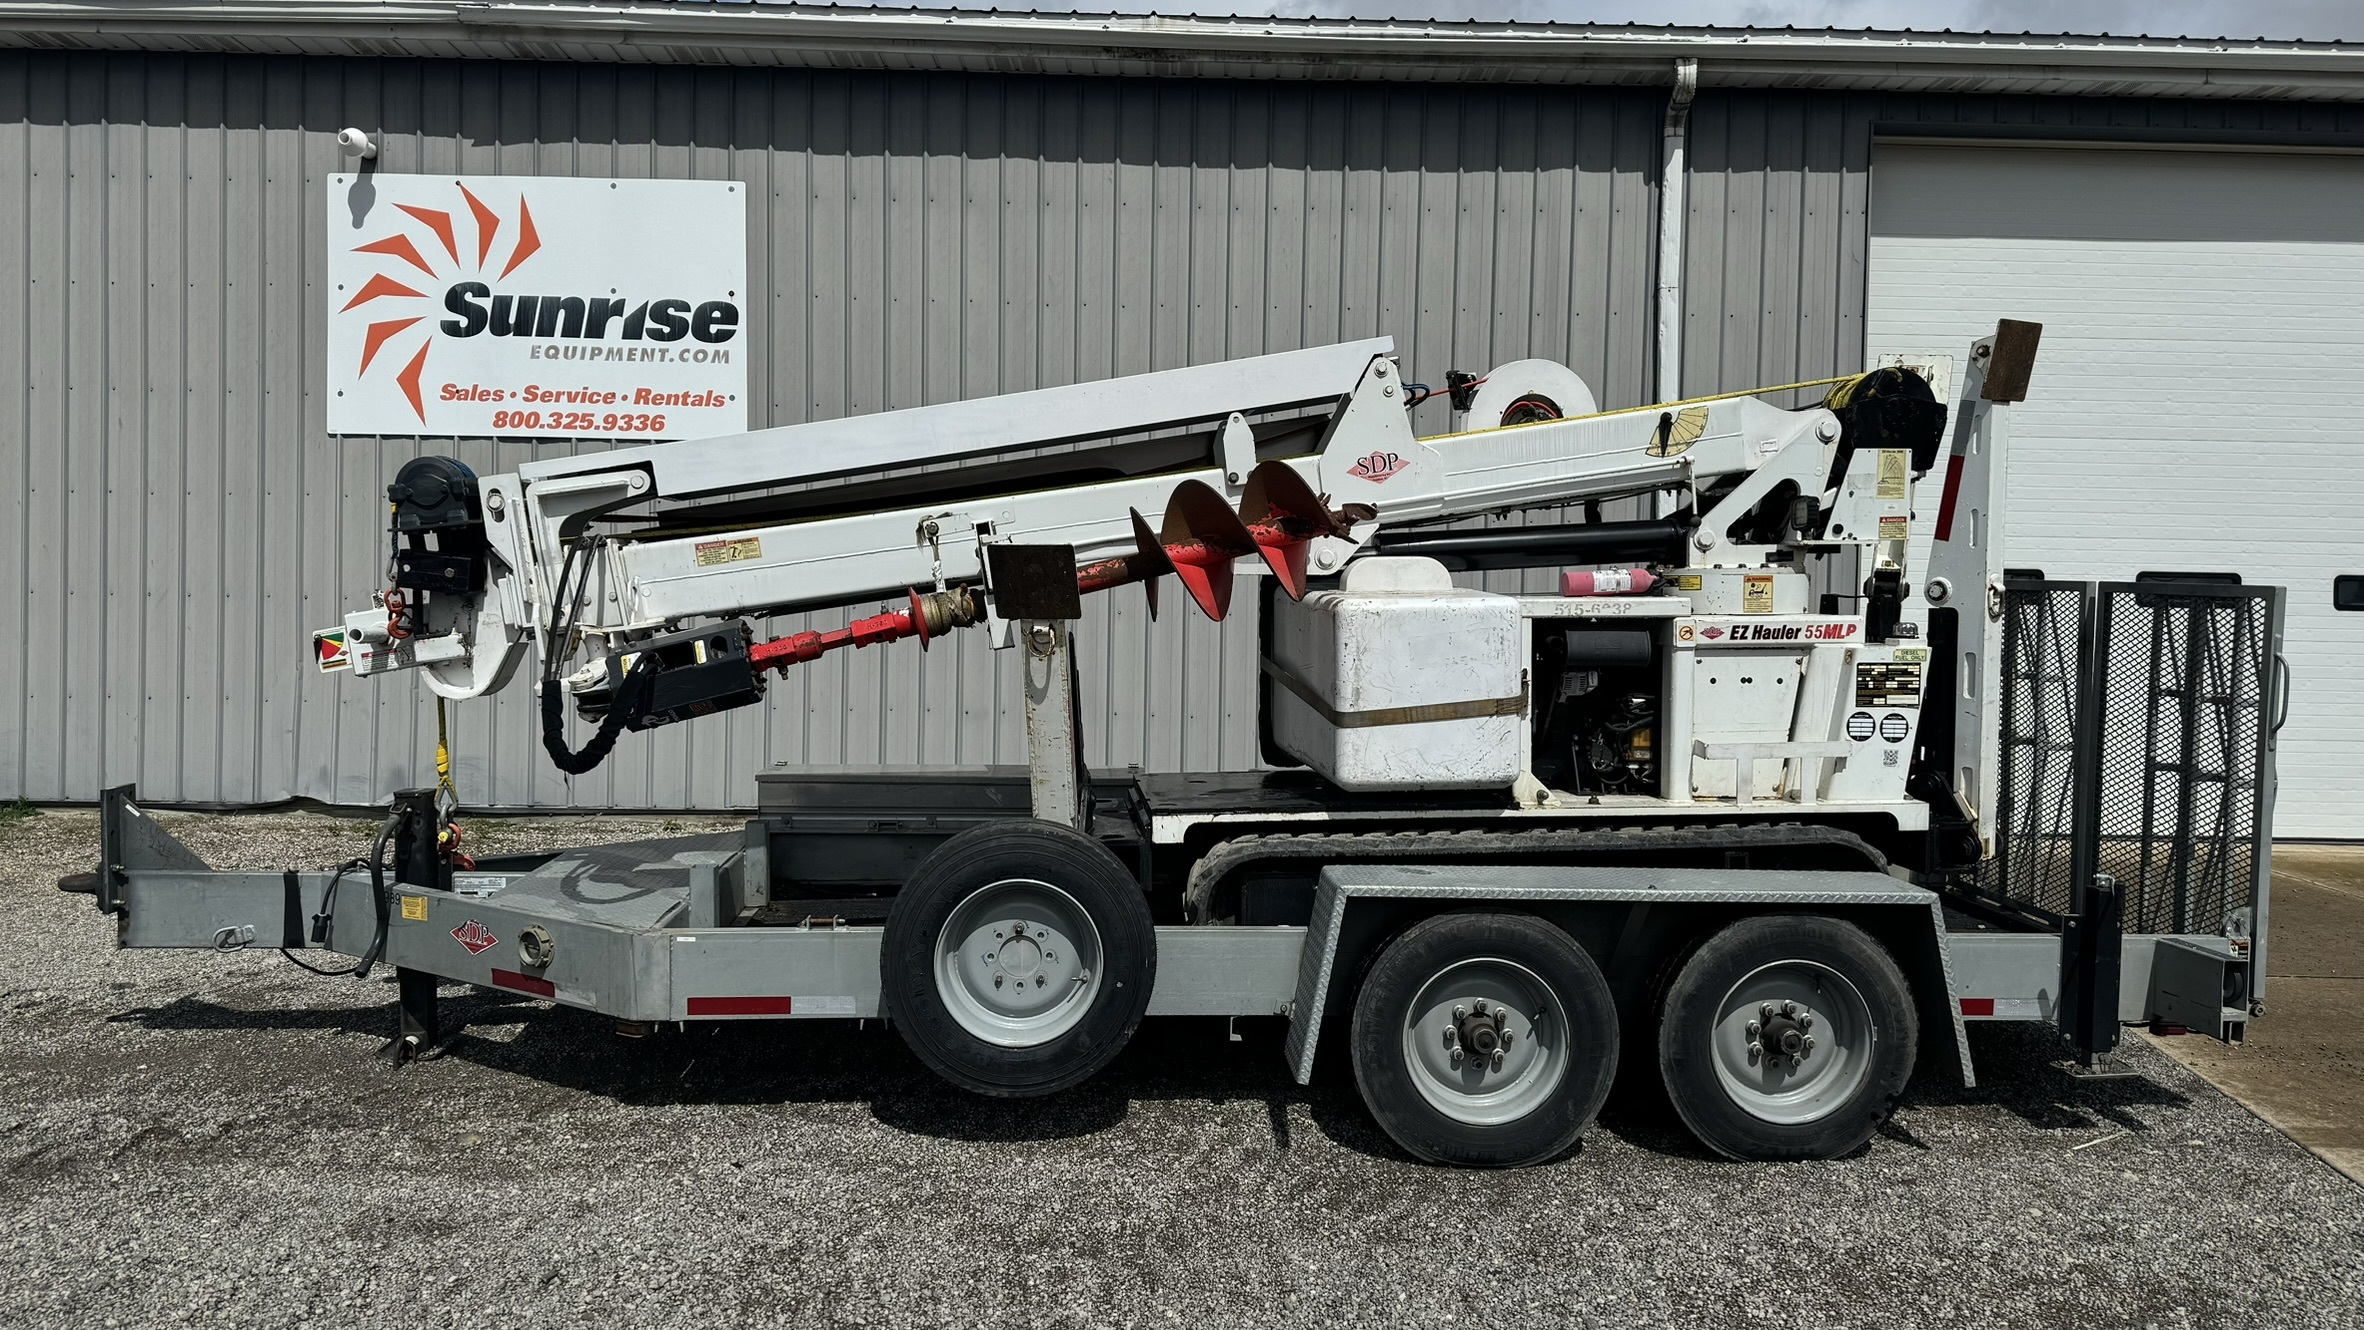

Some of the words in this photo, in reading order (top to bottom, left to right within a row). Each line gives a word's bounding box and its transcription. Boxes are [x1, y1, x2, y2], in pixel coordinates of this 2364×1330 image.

[440, 281, 739, 344] Sunrise
[529, 345, 731, 364] EQUIPMENT.COM
[440, 383, 505, 402] Sales
[522, 385, 616, 405] Service
[633, 387, 726, 408] Rentals
[492, 410, 666, 432] 800.325.9336
[1357, 452, 1399, 476] SDP
[1729, 625, 1749, 640] EZ
[1751, 625, 1802, 640] Hauler
[1804, 623, 1857, 640] 55MLP
[458, 919, 490, 945] SDP
